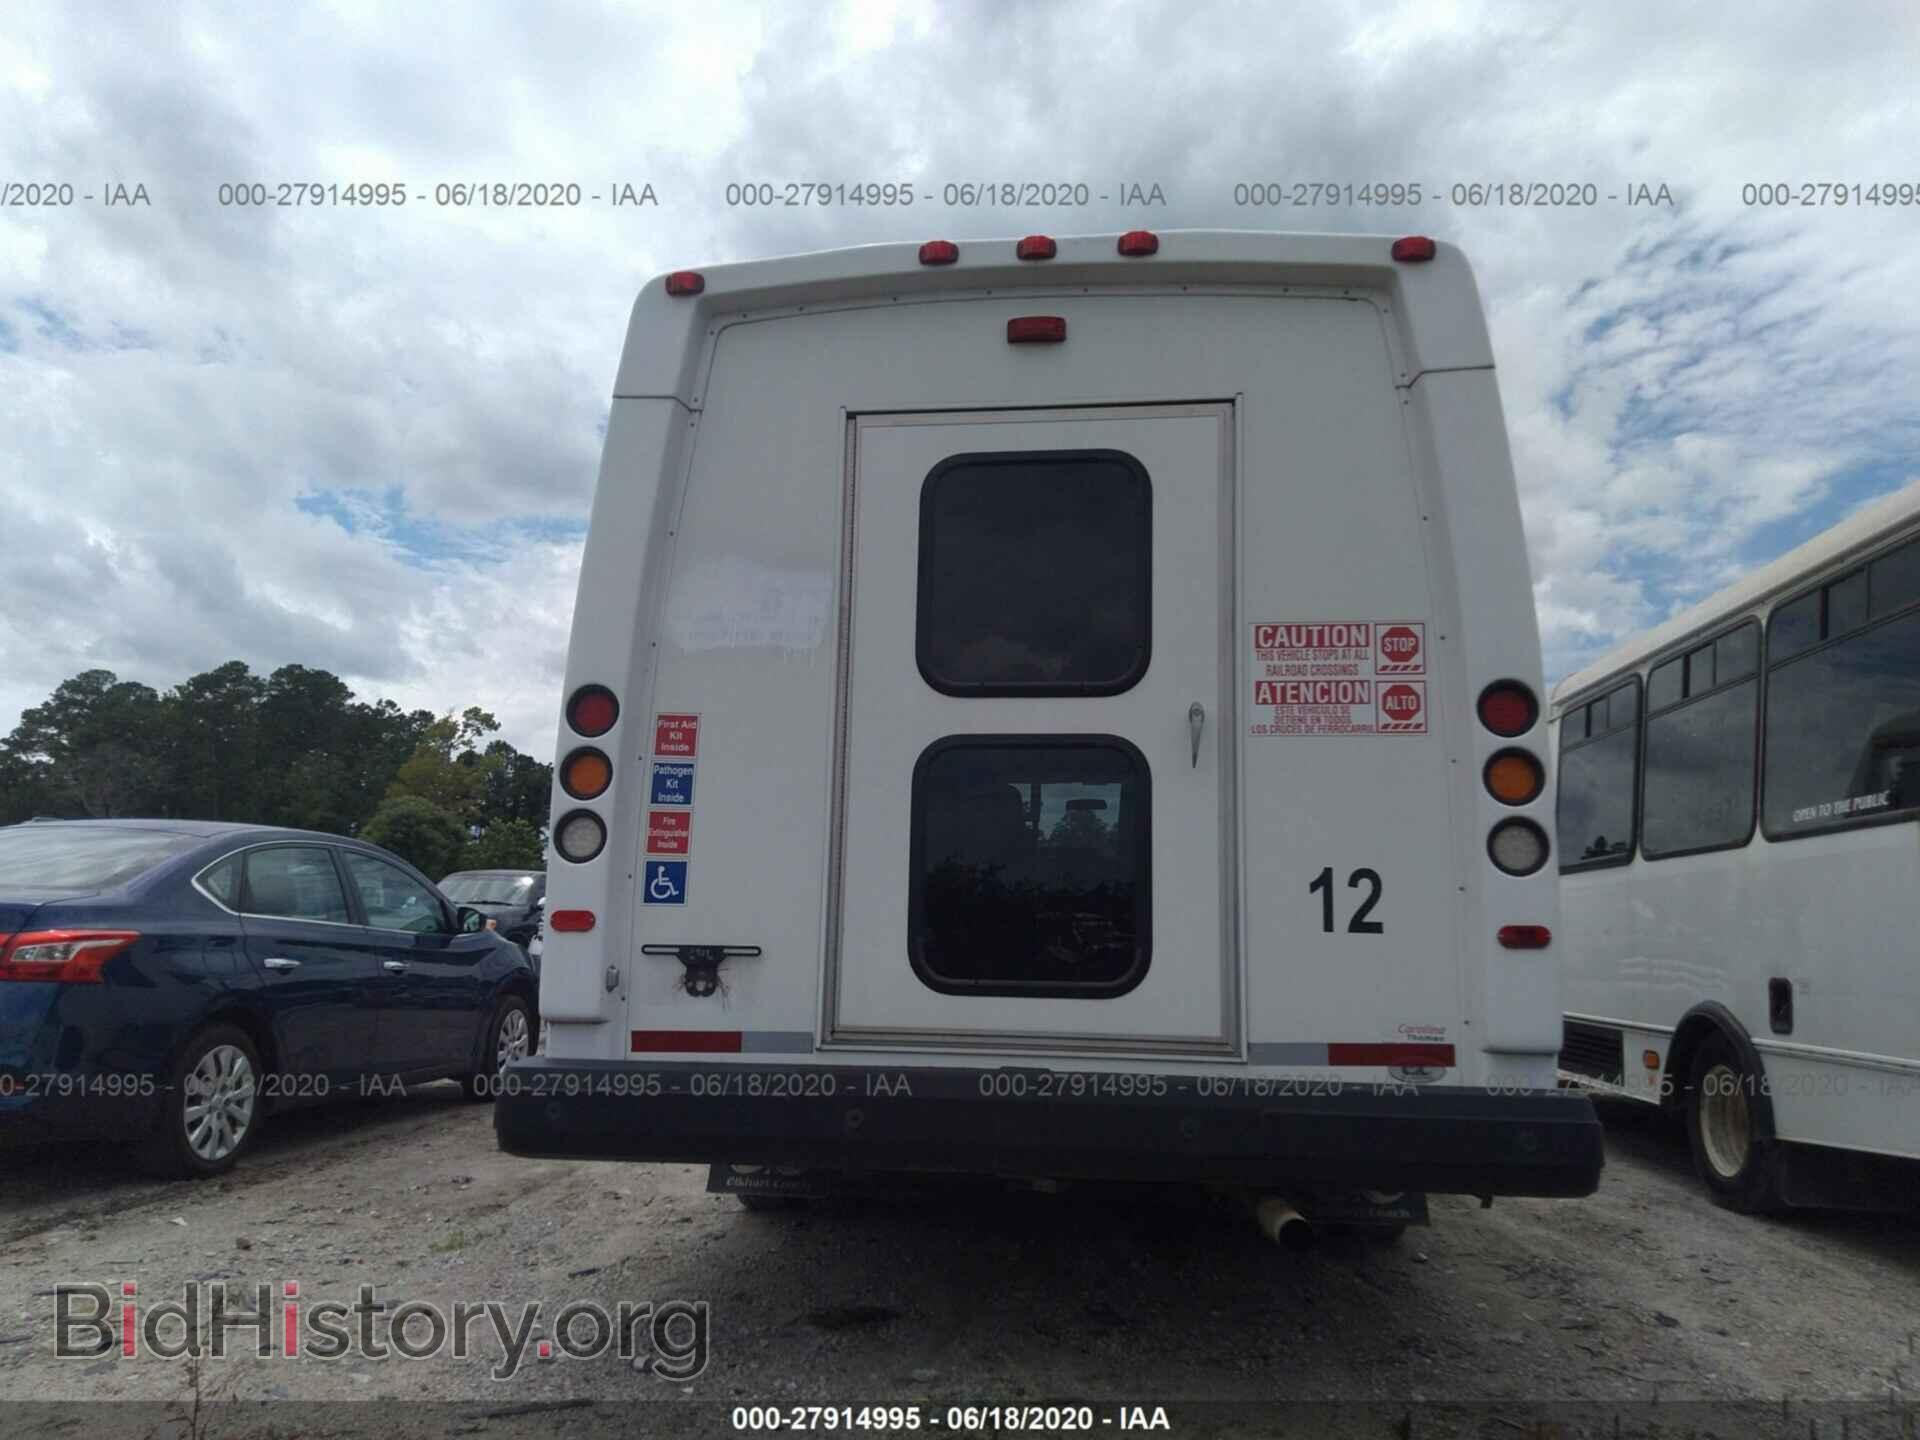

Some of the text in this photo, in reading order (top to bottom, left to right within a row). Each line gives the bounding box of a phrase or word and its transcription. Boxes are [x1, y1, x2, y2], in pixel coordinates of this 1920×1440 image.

[1257, 625, 1367, 648] CAUTION
[1383, 637, 1416, 652] STOP
[1276, 649, 1310, 661] VEHICLE
[1312, 649, 1339, 661] STOPS
[1341, 649, 1352, 661] AT
[1354, 649, 1369, 661] ALL
[1257, 682, 1369, 704] ATENCION
[1385, 696, 1417, 710] ALTO
[658, 719, 697, 729] First Aid
[1251, 724, 1267, 734] LOS
[669, 731, 683, 741] Kit
[660, 742, 690, 752] Inside
[654, 765, 694, 778] Pathogen
[665, 778, 679, 789] Kit
[658, 792, 685, 803] Inside
[1792, 790, 1891, 822] OPEN TO THE PUBLIC
[1309, 867, 1384, 934] 12
